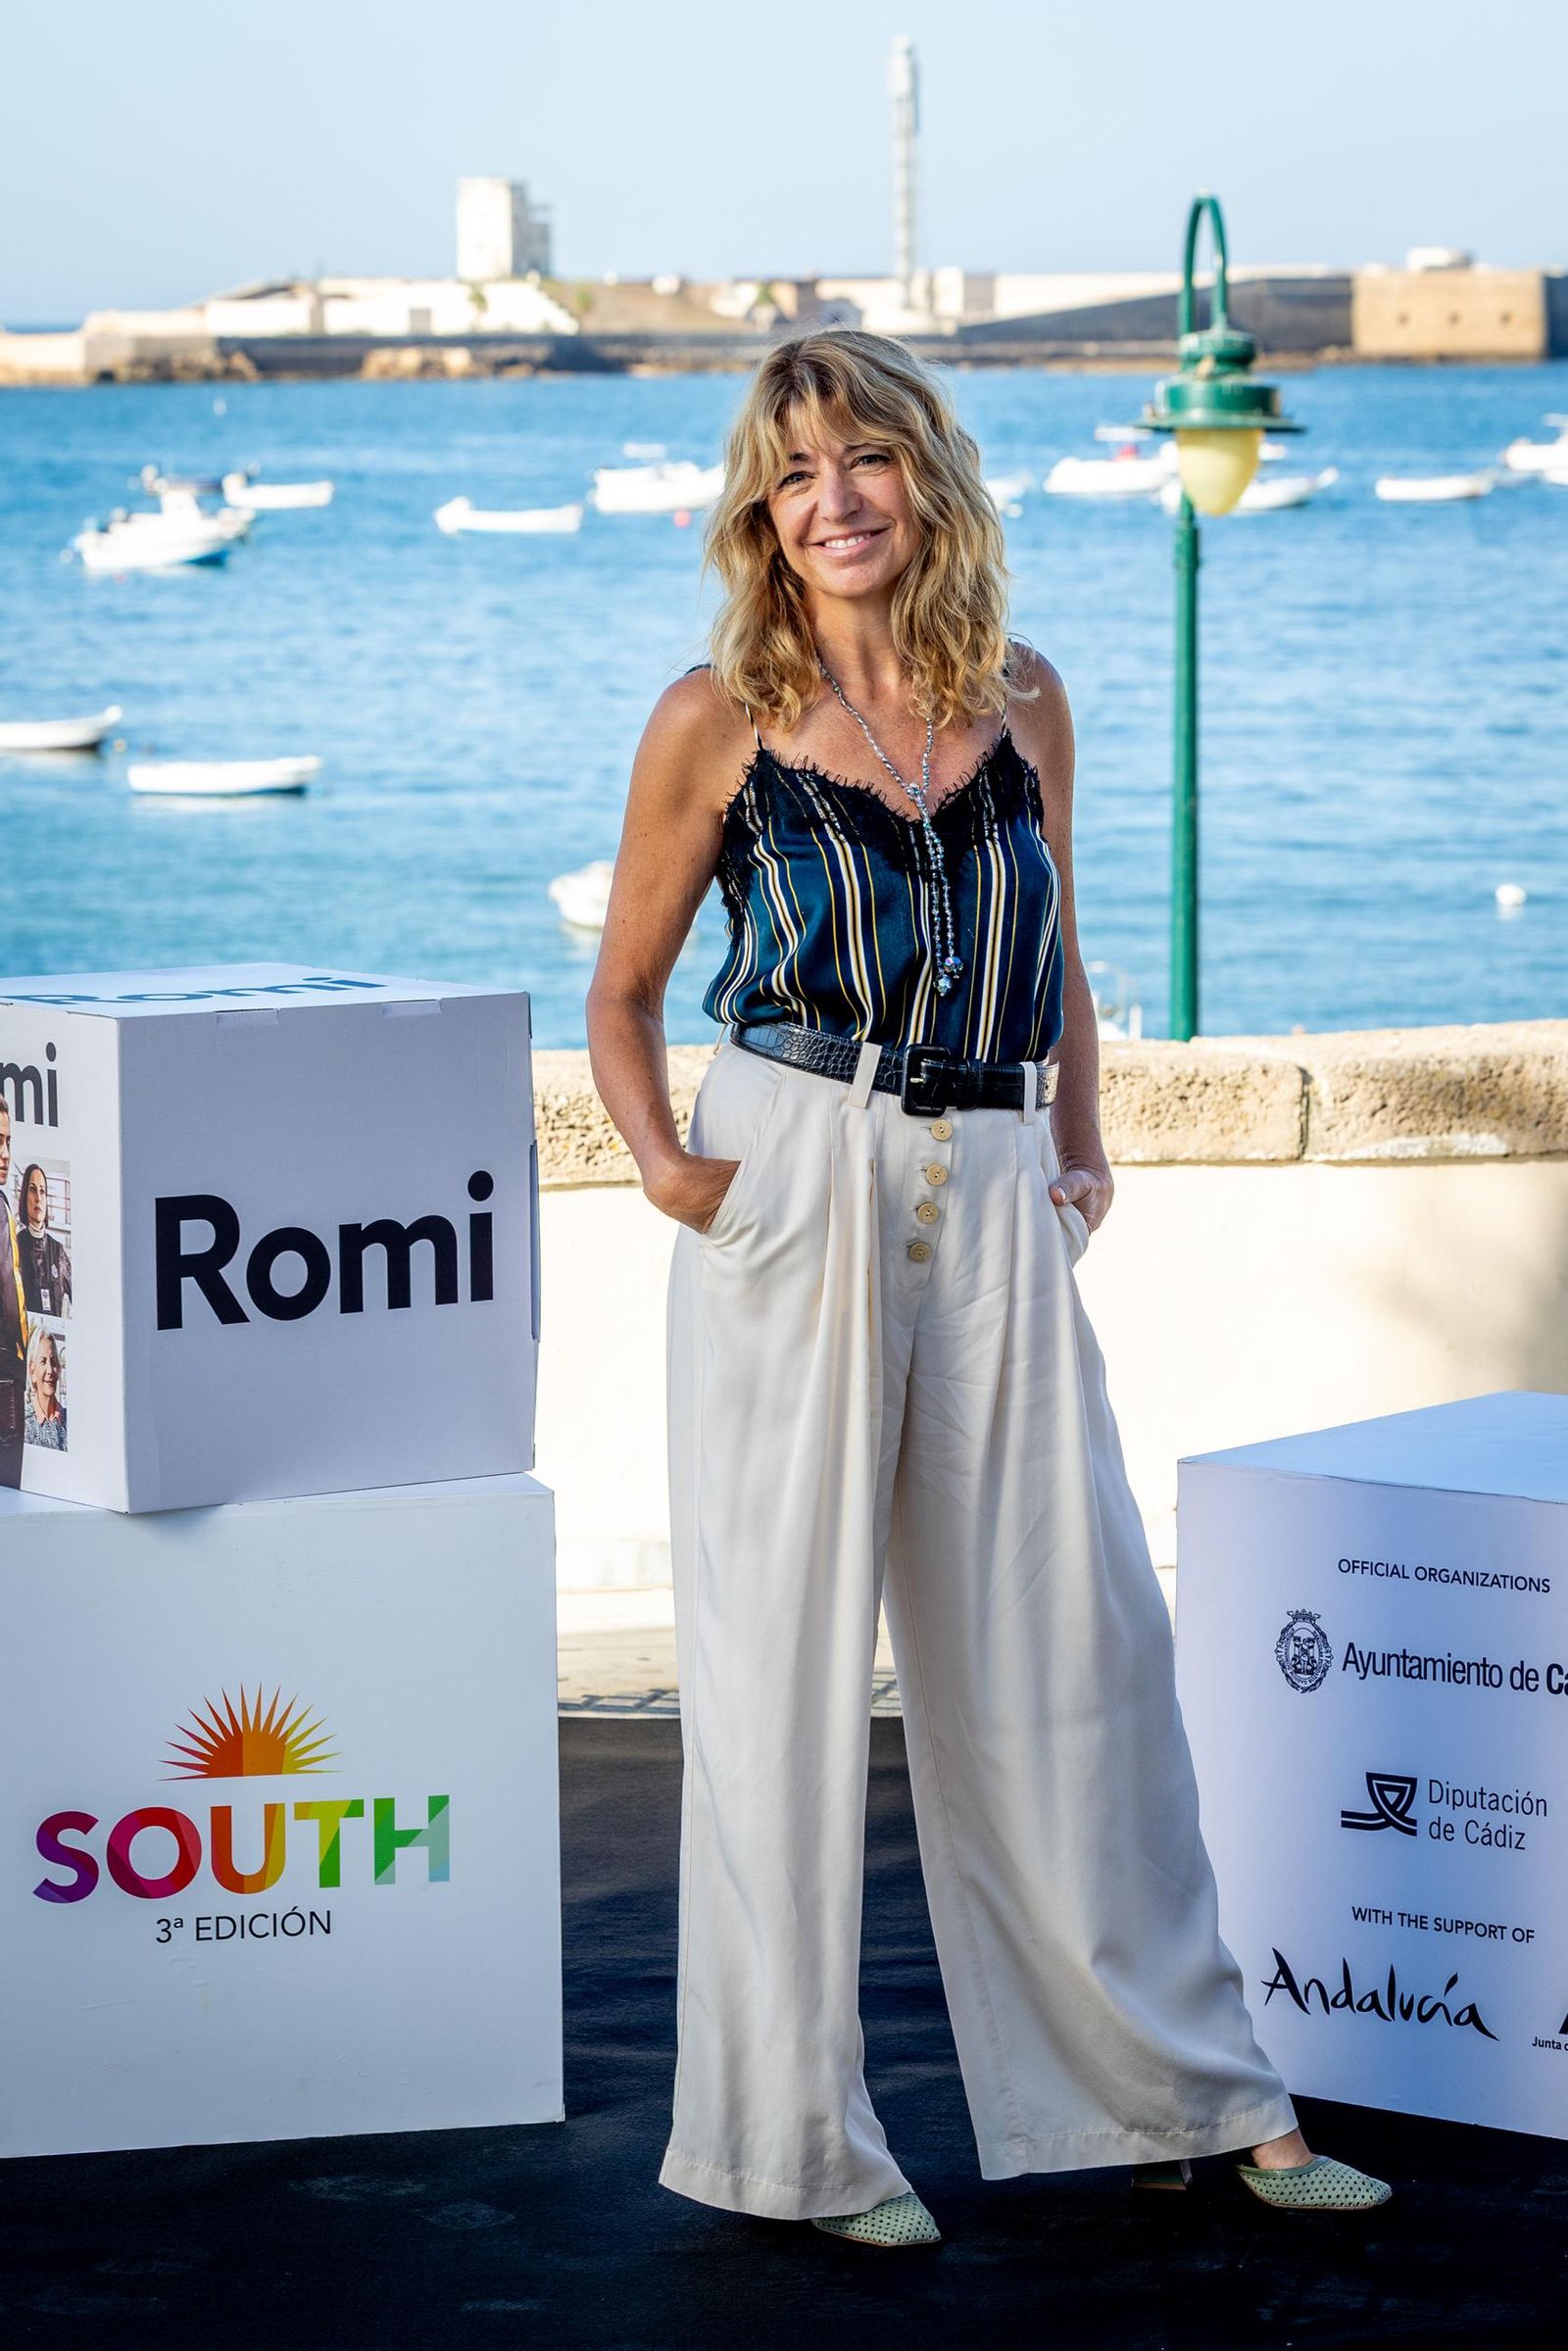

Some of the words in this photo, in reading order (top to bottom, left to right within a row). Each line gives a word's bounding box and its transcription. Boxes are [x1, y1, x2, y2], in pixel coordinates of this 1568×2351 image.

[0, 977, 387, 1004] Romi
[156, 1171, 493, 1330] Romi
[1338, 1558, 1410, 1580] OFFICIAL
[1414, 1565, 1550, 1593] ORGANIZATIONS
[1342, 1641, 1503, 1689] Ayuntamiento
[1509, 1660, 1540, 1692] de
[1545, 1663, 1568, 1696] C
[1429, 1780, 1547, 1817] Diputación
[32, 1794, 450, 1904] SOUTH
[1428, 1815, 1455, 1842] de
[1465, 1820, 1526, 1850] Cádiz
[195, 1905, 331, 1941] EDICIÓN
[1351, 1905, 1393, 1926] WITH
[1396, 1912, 1429, 1931] THE
[1433, 1917, 1508, 1940] SUPPORT
[1511, 1927, 1535, 1944] OF
[1260, 1947, 1499, 2042] Andalucía
[1531, 2035, 1562, 2051] Junta
